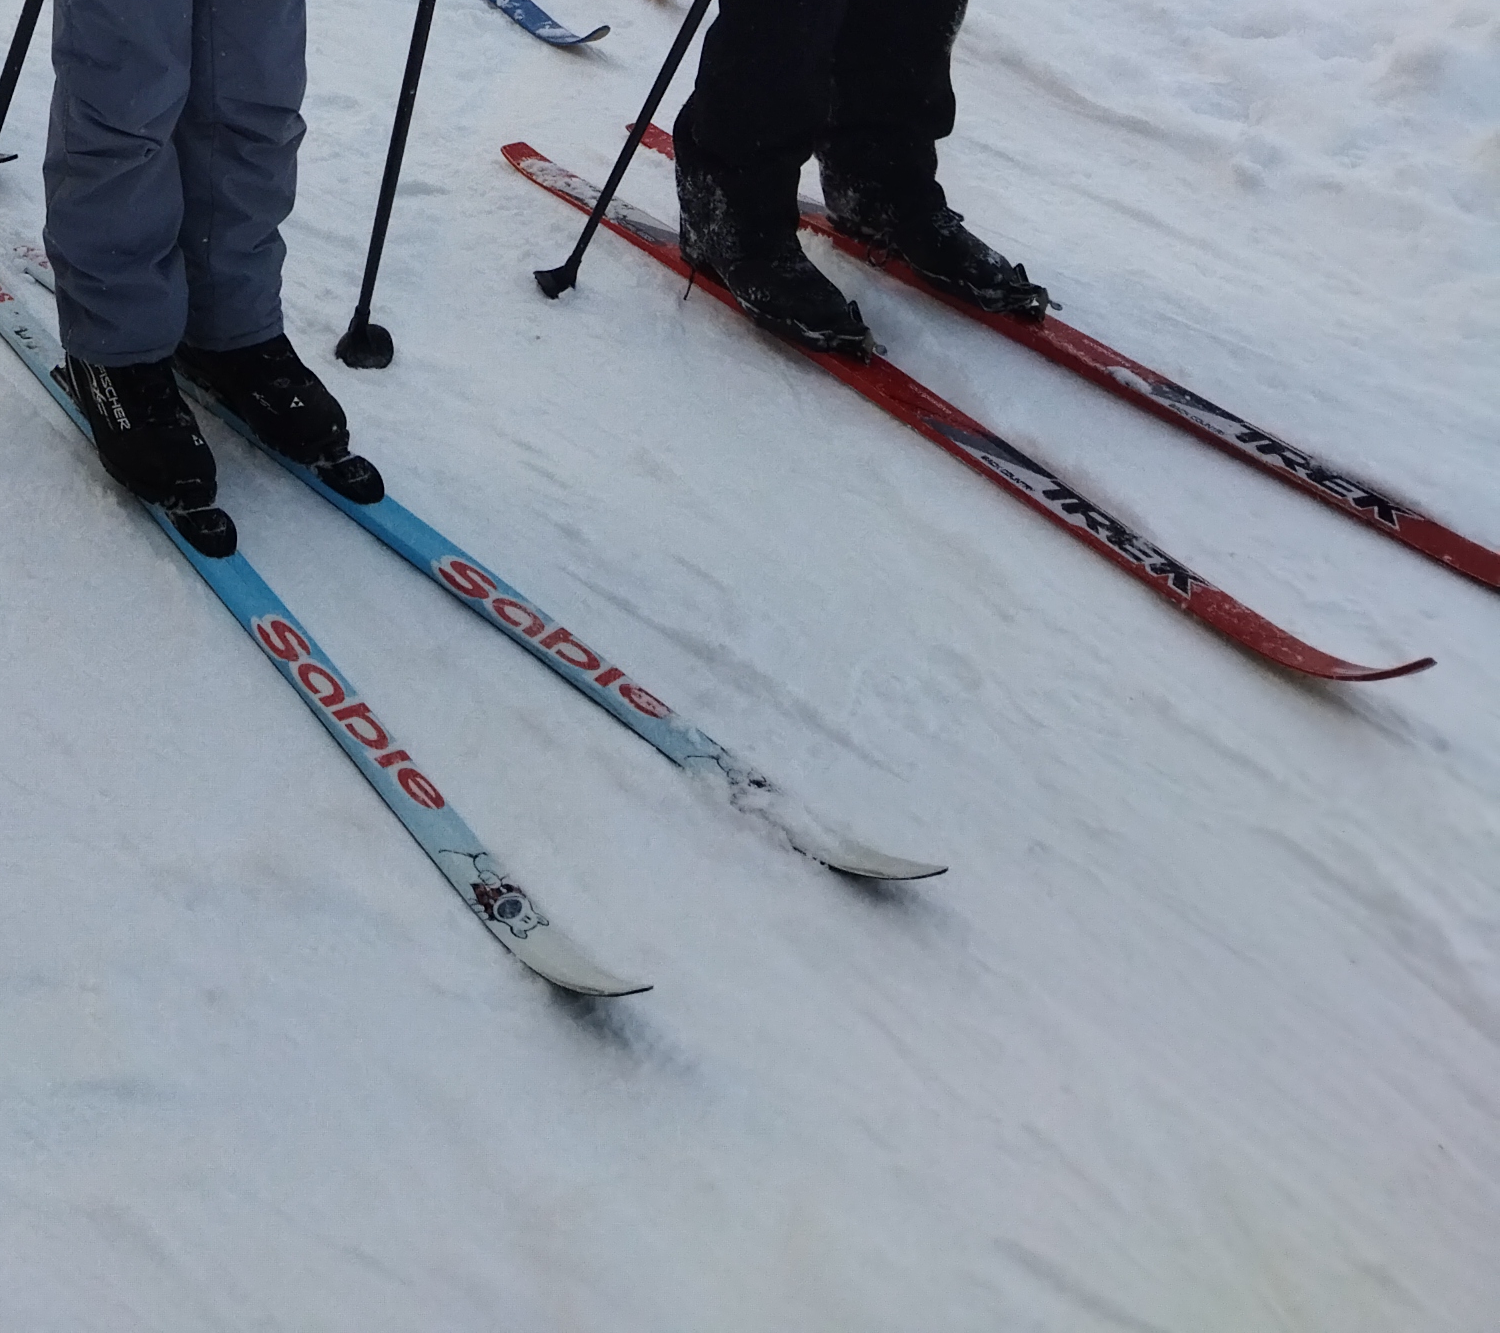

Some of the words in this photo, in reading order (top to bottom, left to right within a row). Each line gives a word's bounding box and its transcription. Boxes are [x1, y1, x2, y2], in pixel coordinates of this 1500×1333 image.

[99, 365, 131, 431] FISCHER
[1235, 422, 1416, 528] TREK
[1042, 478, 1209, 596] TREK
